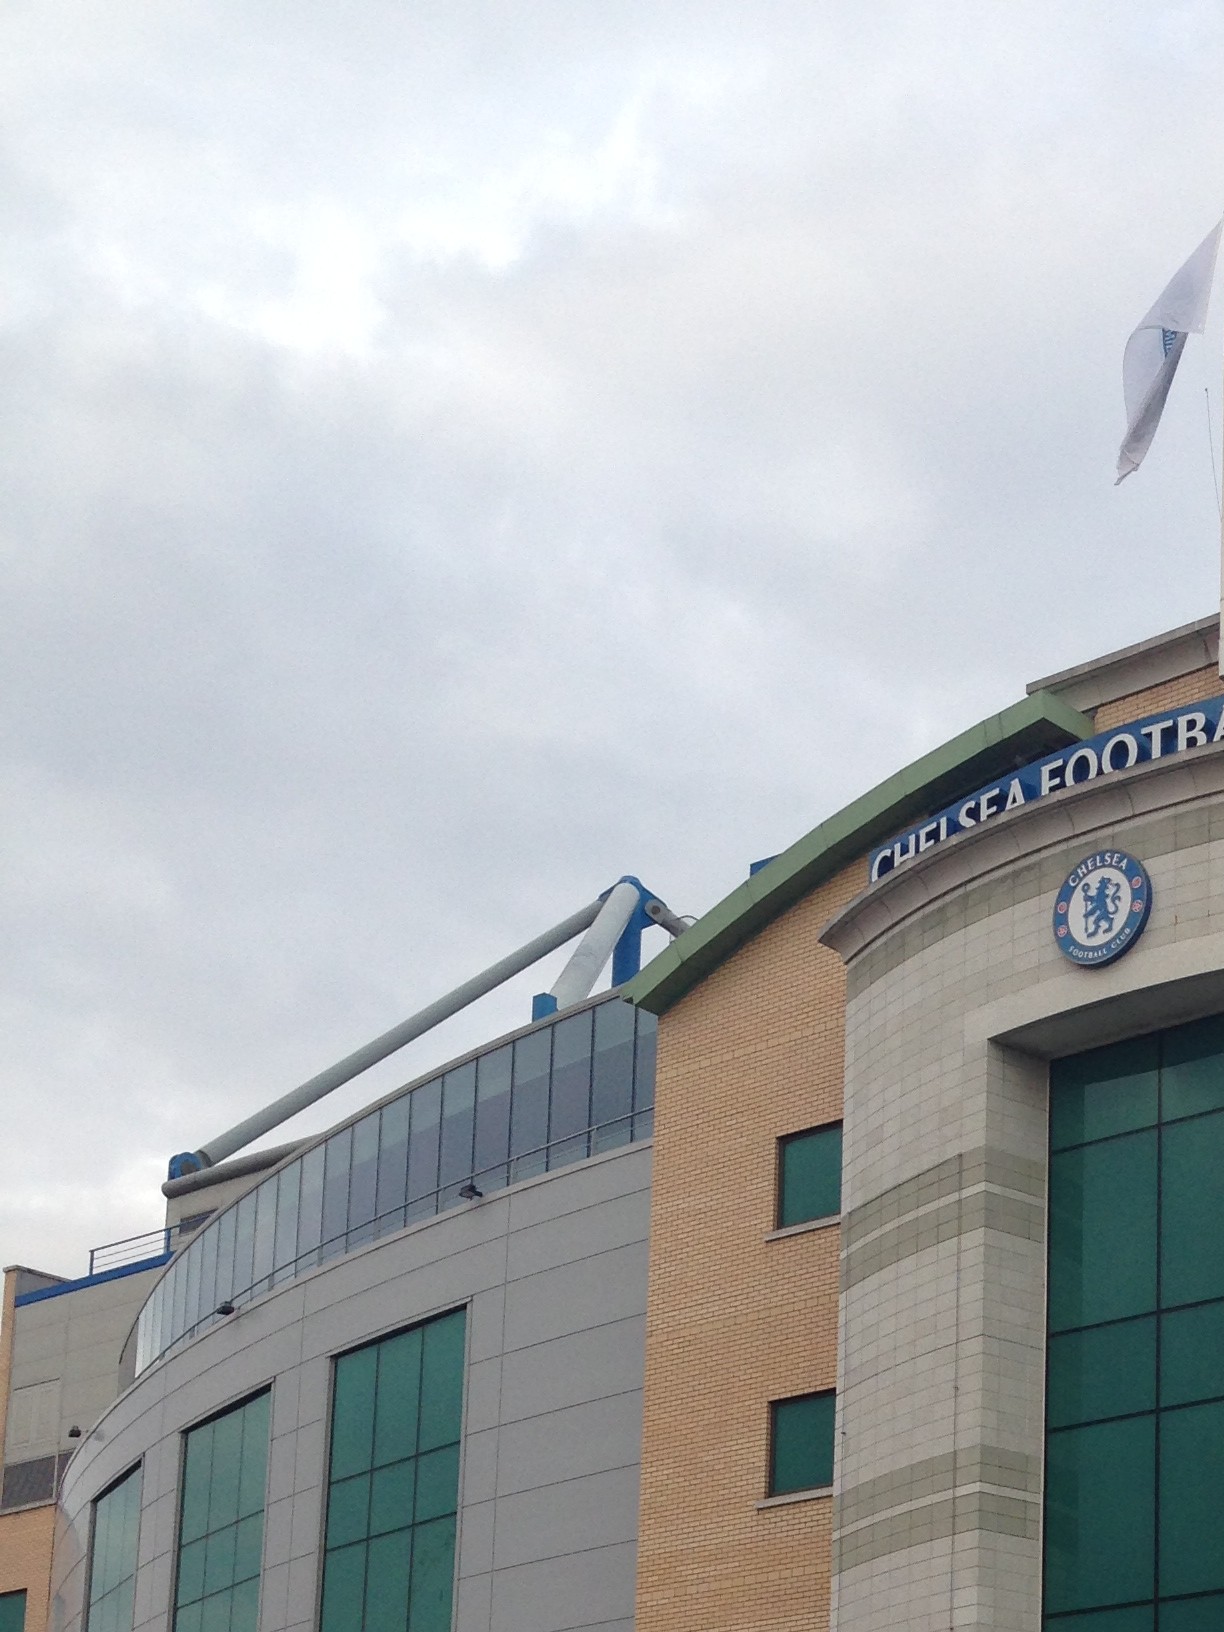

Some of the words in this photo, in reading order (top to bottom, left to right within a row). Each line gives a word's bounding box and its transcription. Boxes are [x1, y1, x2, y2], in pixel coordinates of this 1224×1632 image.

[1068, 852, 1129, 888] CHELSEA
[1068, 945, 1108, 960] FOOTBALL
[1110, 927, 1132, 949] CLUB
